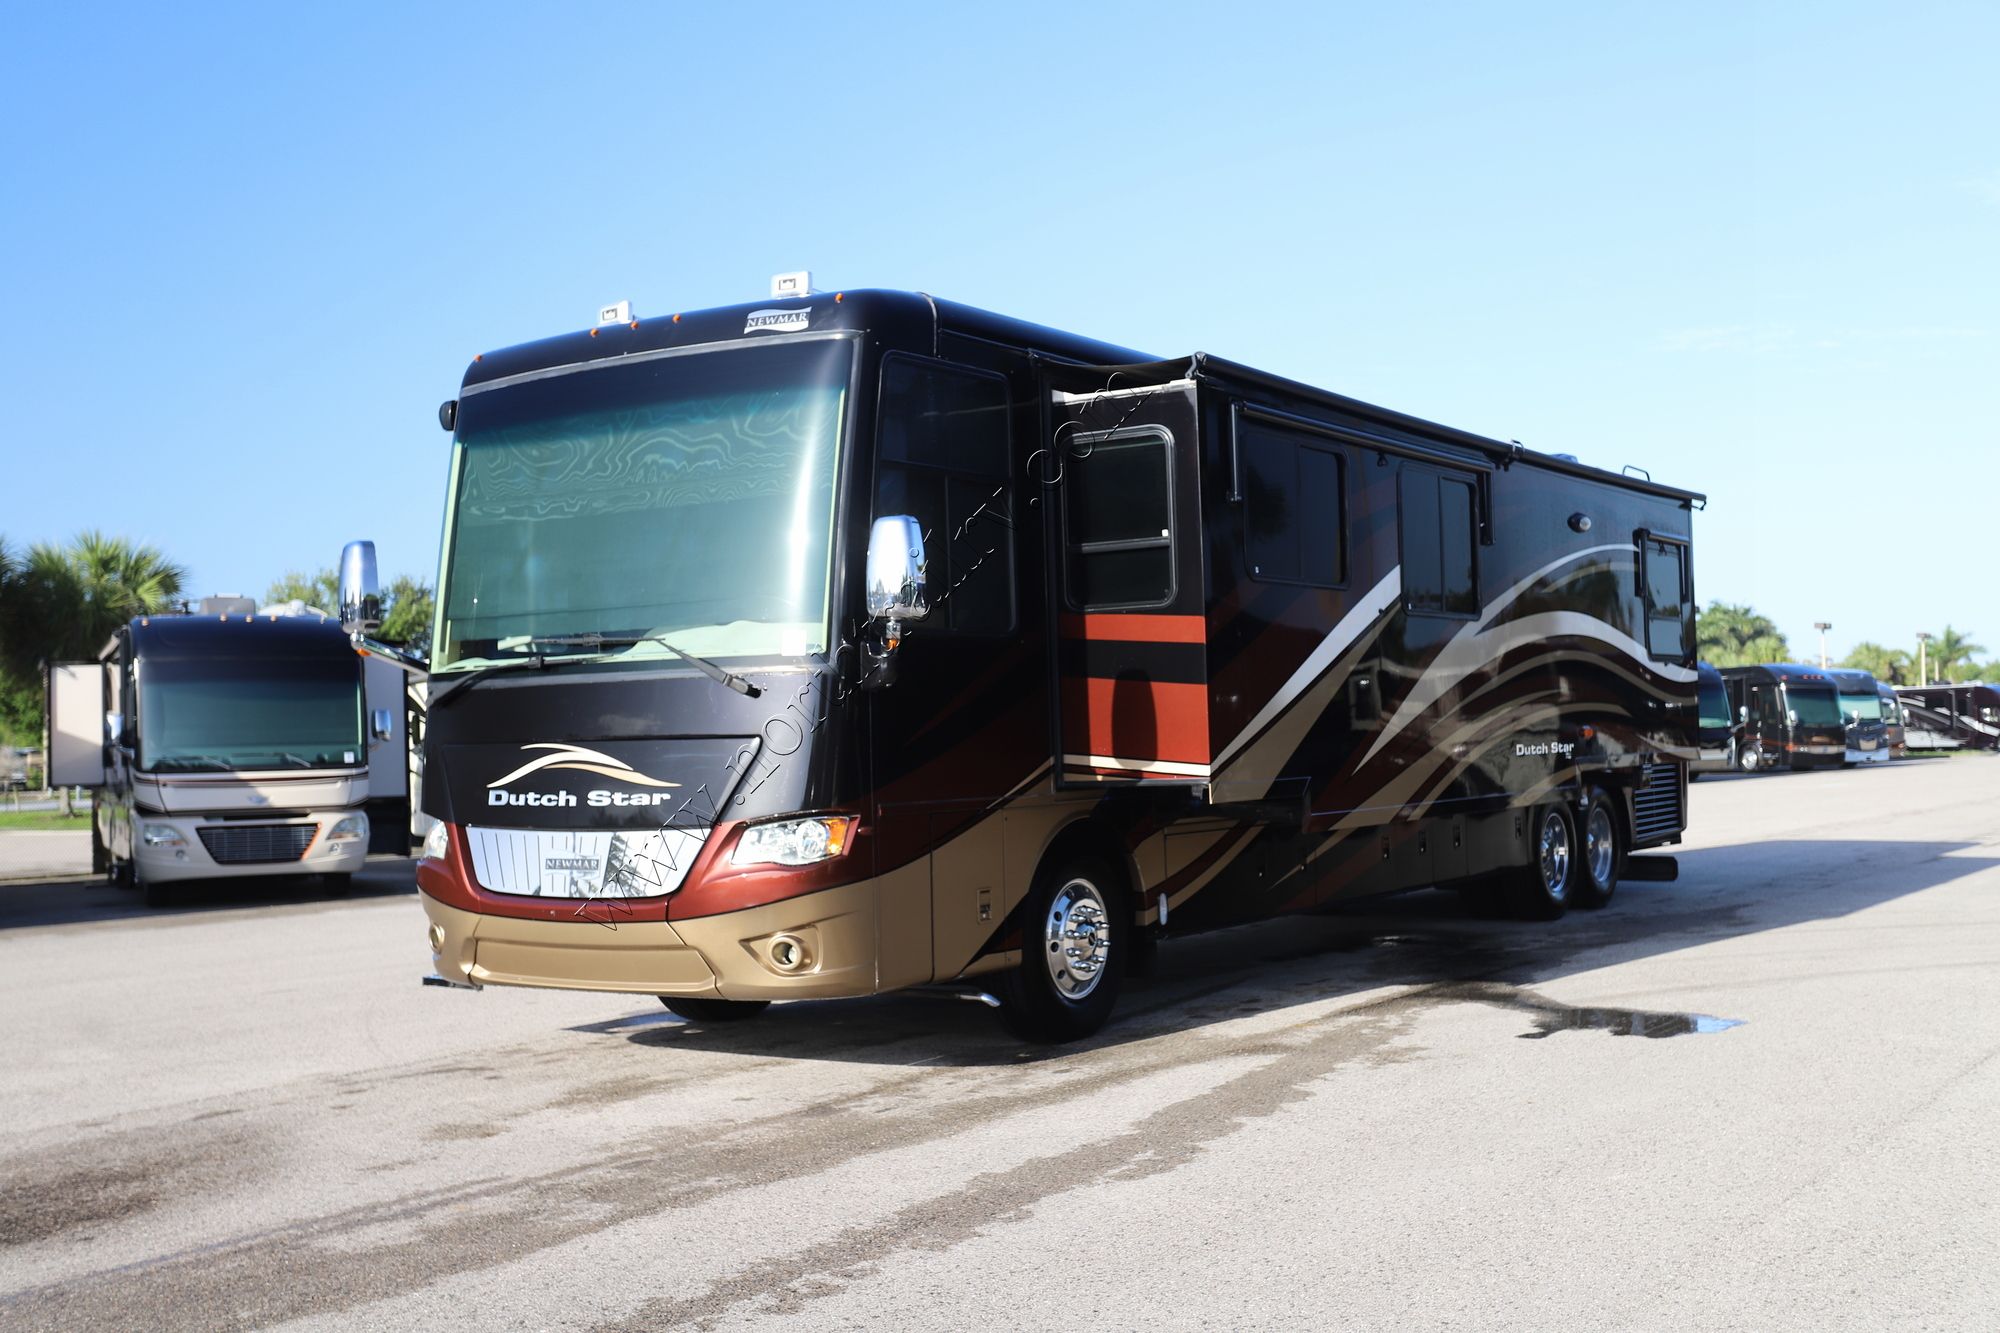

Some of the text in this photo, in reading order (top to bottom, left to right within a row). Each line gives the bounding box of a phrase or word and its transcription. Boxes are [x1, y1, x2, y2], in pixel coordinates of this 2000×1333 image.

[746, 312, 808, 328] NEWMAR
[1516, 742, 1549, 756] Dutch
[1551, 741, 1575, 754] Star
[488, 789, 671, 807] Dutch Star
[545, 858, 600, 871] NEWMAR
